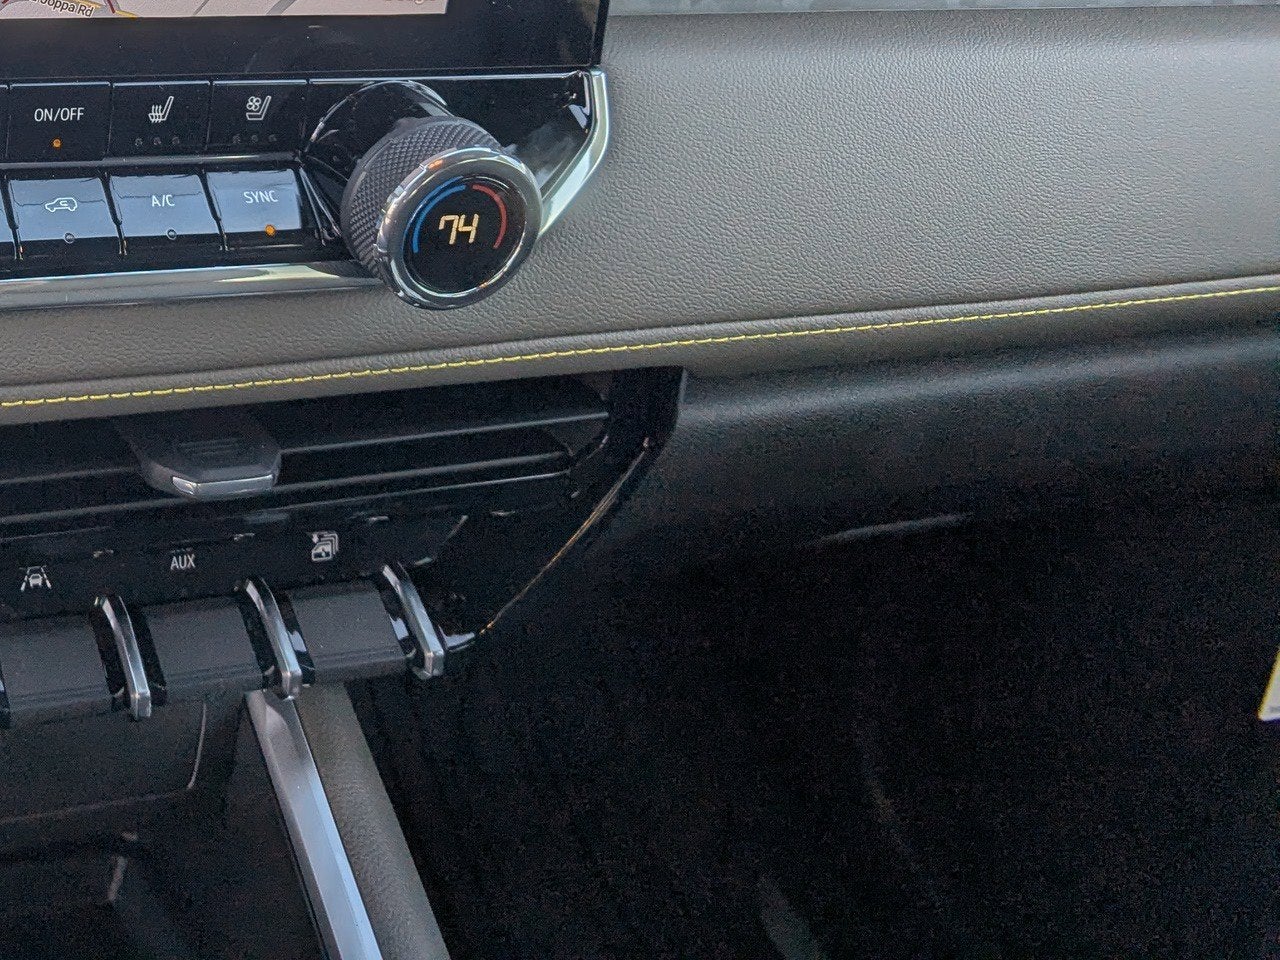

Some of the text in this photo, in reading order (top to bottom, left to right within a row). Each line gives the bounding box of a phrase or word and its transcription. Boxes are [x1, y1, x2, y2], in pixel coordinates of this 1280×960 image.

[77, 5, 94, 18] Rd
[34, 107, 85, 122] ON/OFF
[151, 194, 175, 207] A/C
[243, 190, 279, 204] SYNC
[439, 213, 480, 245] 74
[170, 553, 196, 570] AUX
